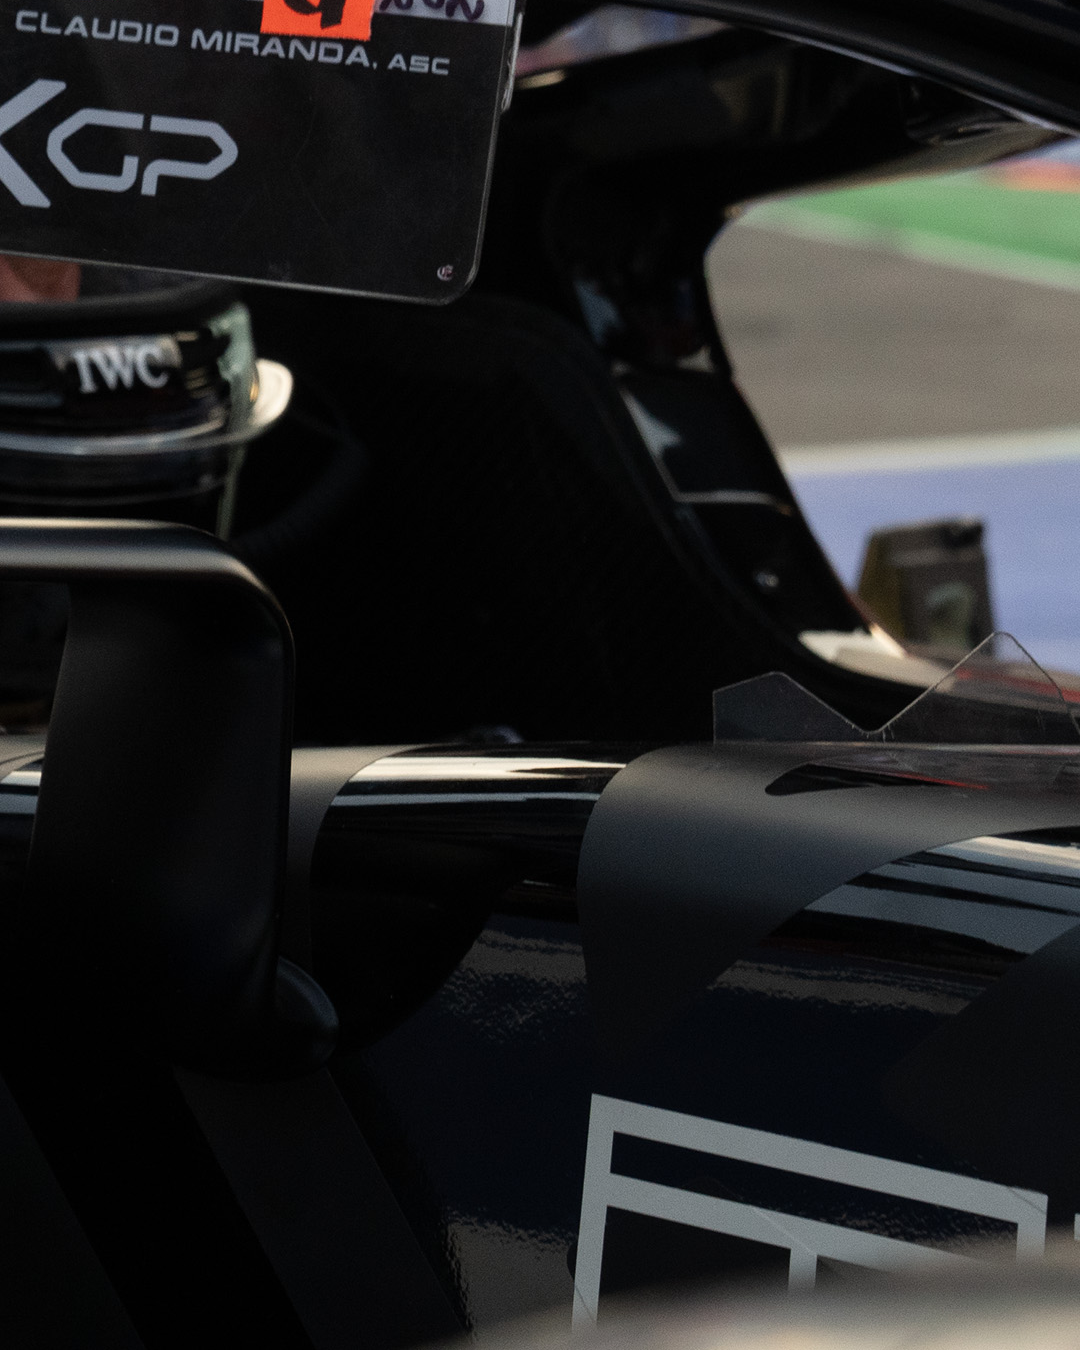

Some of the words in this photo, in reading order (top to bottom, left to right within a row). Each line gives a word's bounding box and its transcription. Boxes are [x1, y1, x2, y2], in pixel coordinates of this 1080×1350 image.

[15, 10, 180, 48] CLAUDIO
[387, 52, 451, 77] ASC
[71, 345, 171, 395] IWC
